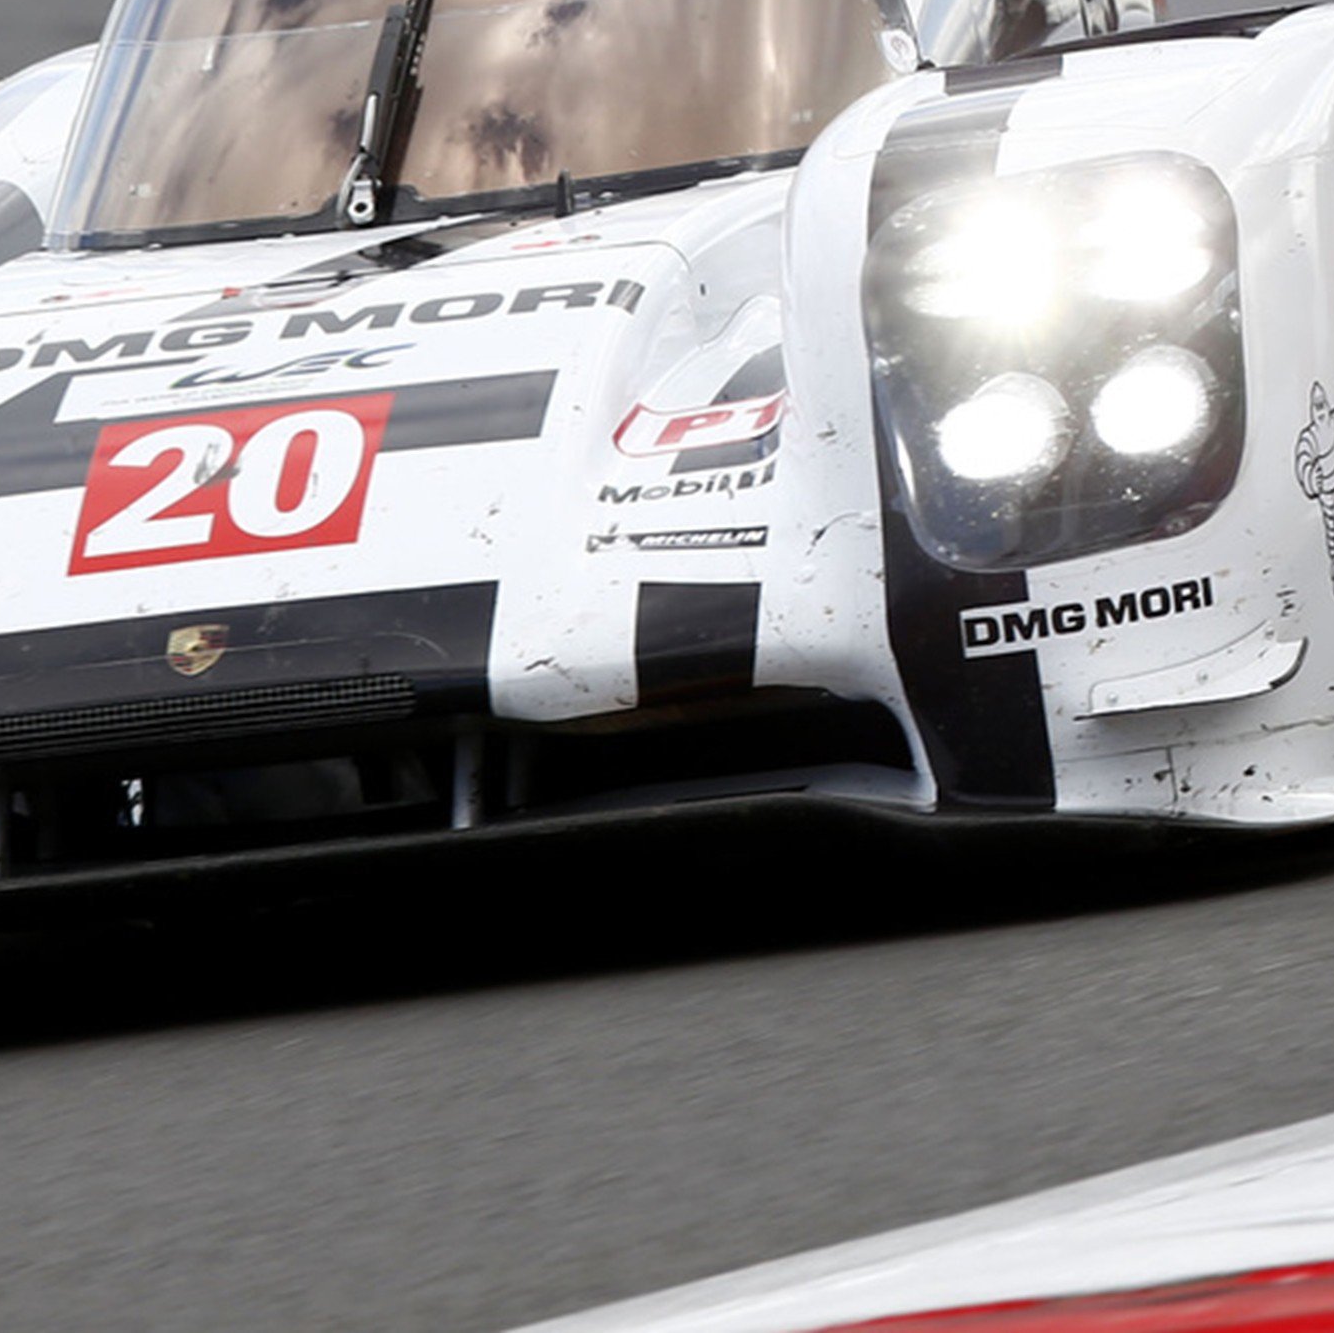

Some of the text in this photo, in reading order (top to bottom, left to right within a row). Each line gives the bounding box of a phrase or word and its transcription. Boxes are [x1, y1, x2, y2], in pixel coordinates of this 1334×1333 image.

[278, 279, 646, 339] MORI
[652, 399, 785, 447] P1
[82, 409, 365, 559] 20
[598, 470, 731, 503] Mobil
[963, 576, 1214, 649] DMG MORI
